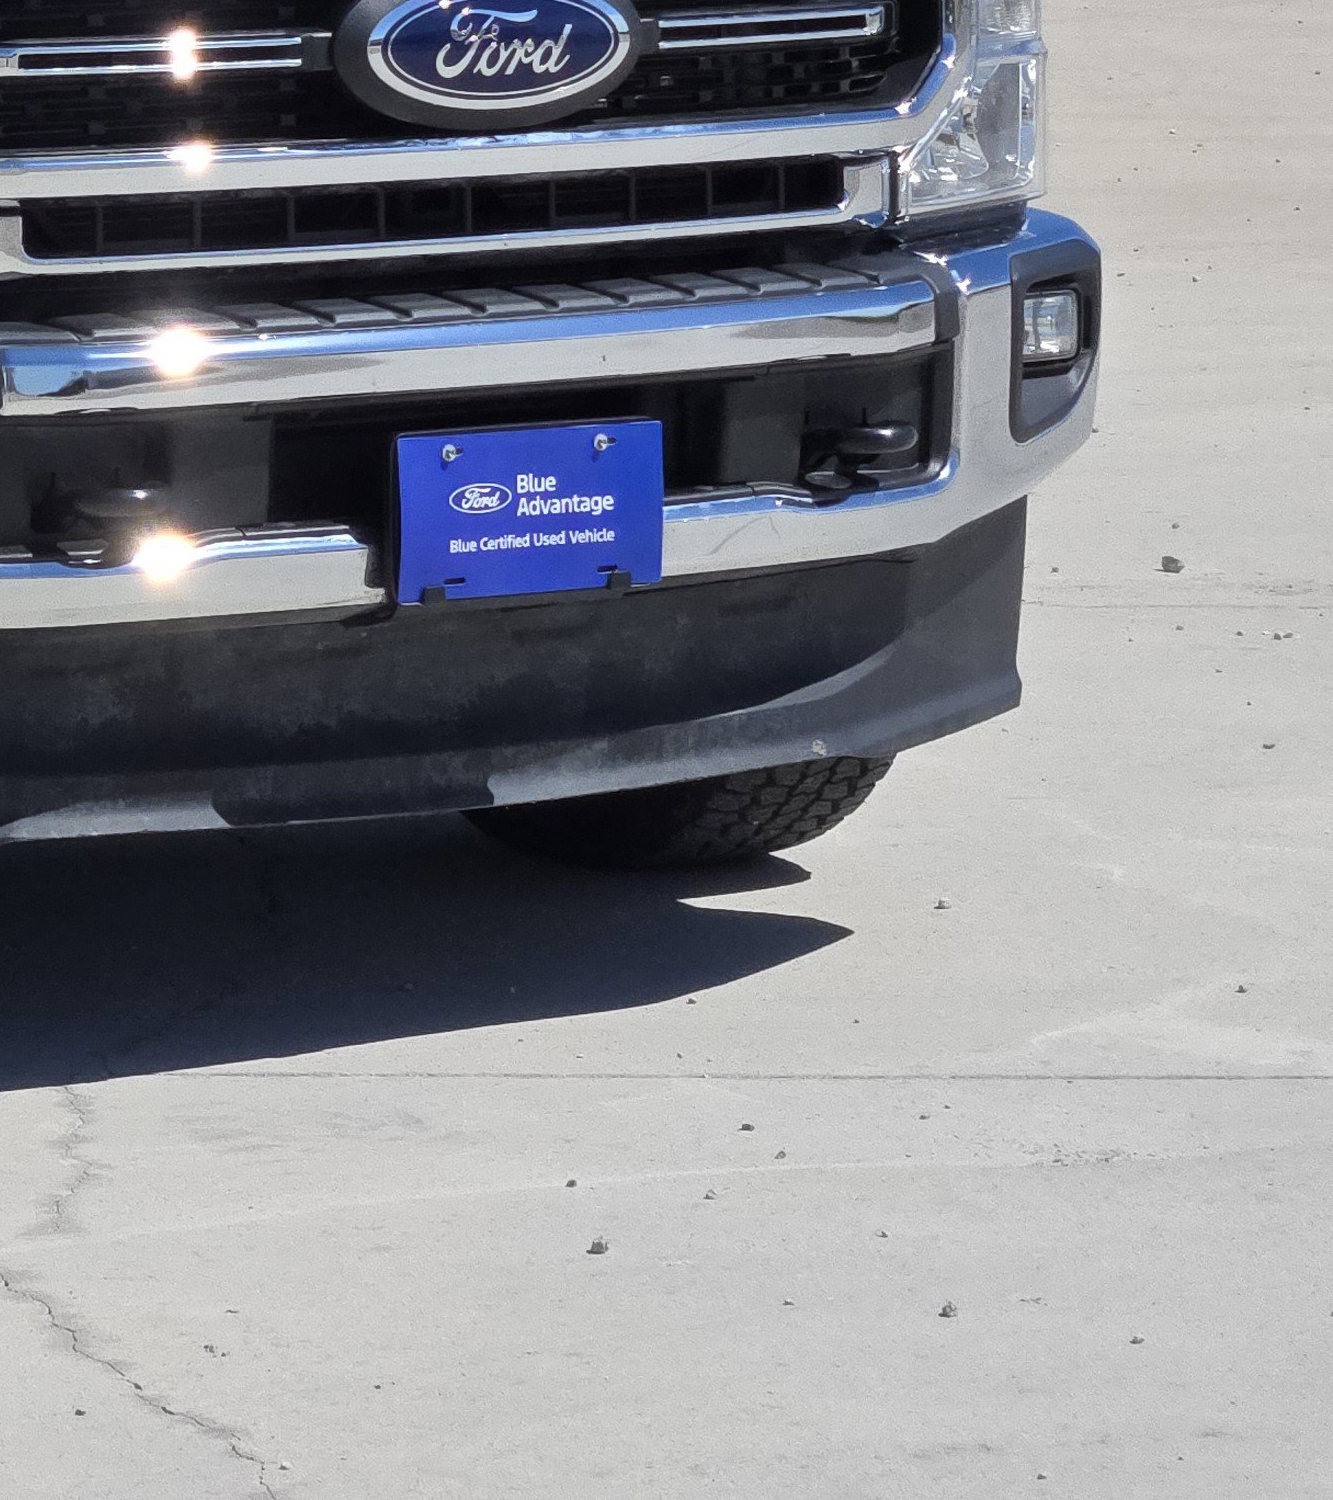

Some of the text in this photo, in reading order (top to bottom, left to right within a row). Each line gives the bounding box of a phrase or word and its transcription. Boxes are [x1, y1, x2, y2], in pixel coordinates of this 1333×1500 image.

[435, 8, 573, 79] Ford
[516, 474, 557, 493] Blue
[461, 487, 500, 510] Ford
[516, 494, 615, 517] Advantage
[449, 527, 615, 554] Blue Certified Used Vehicle
